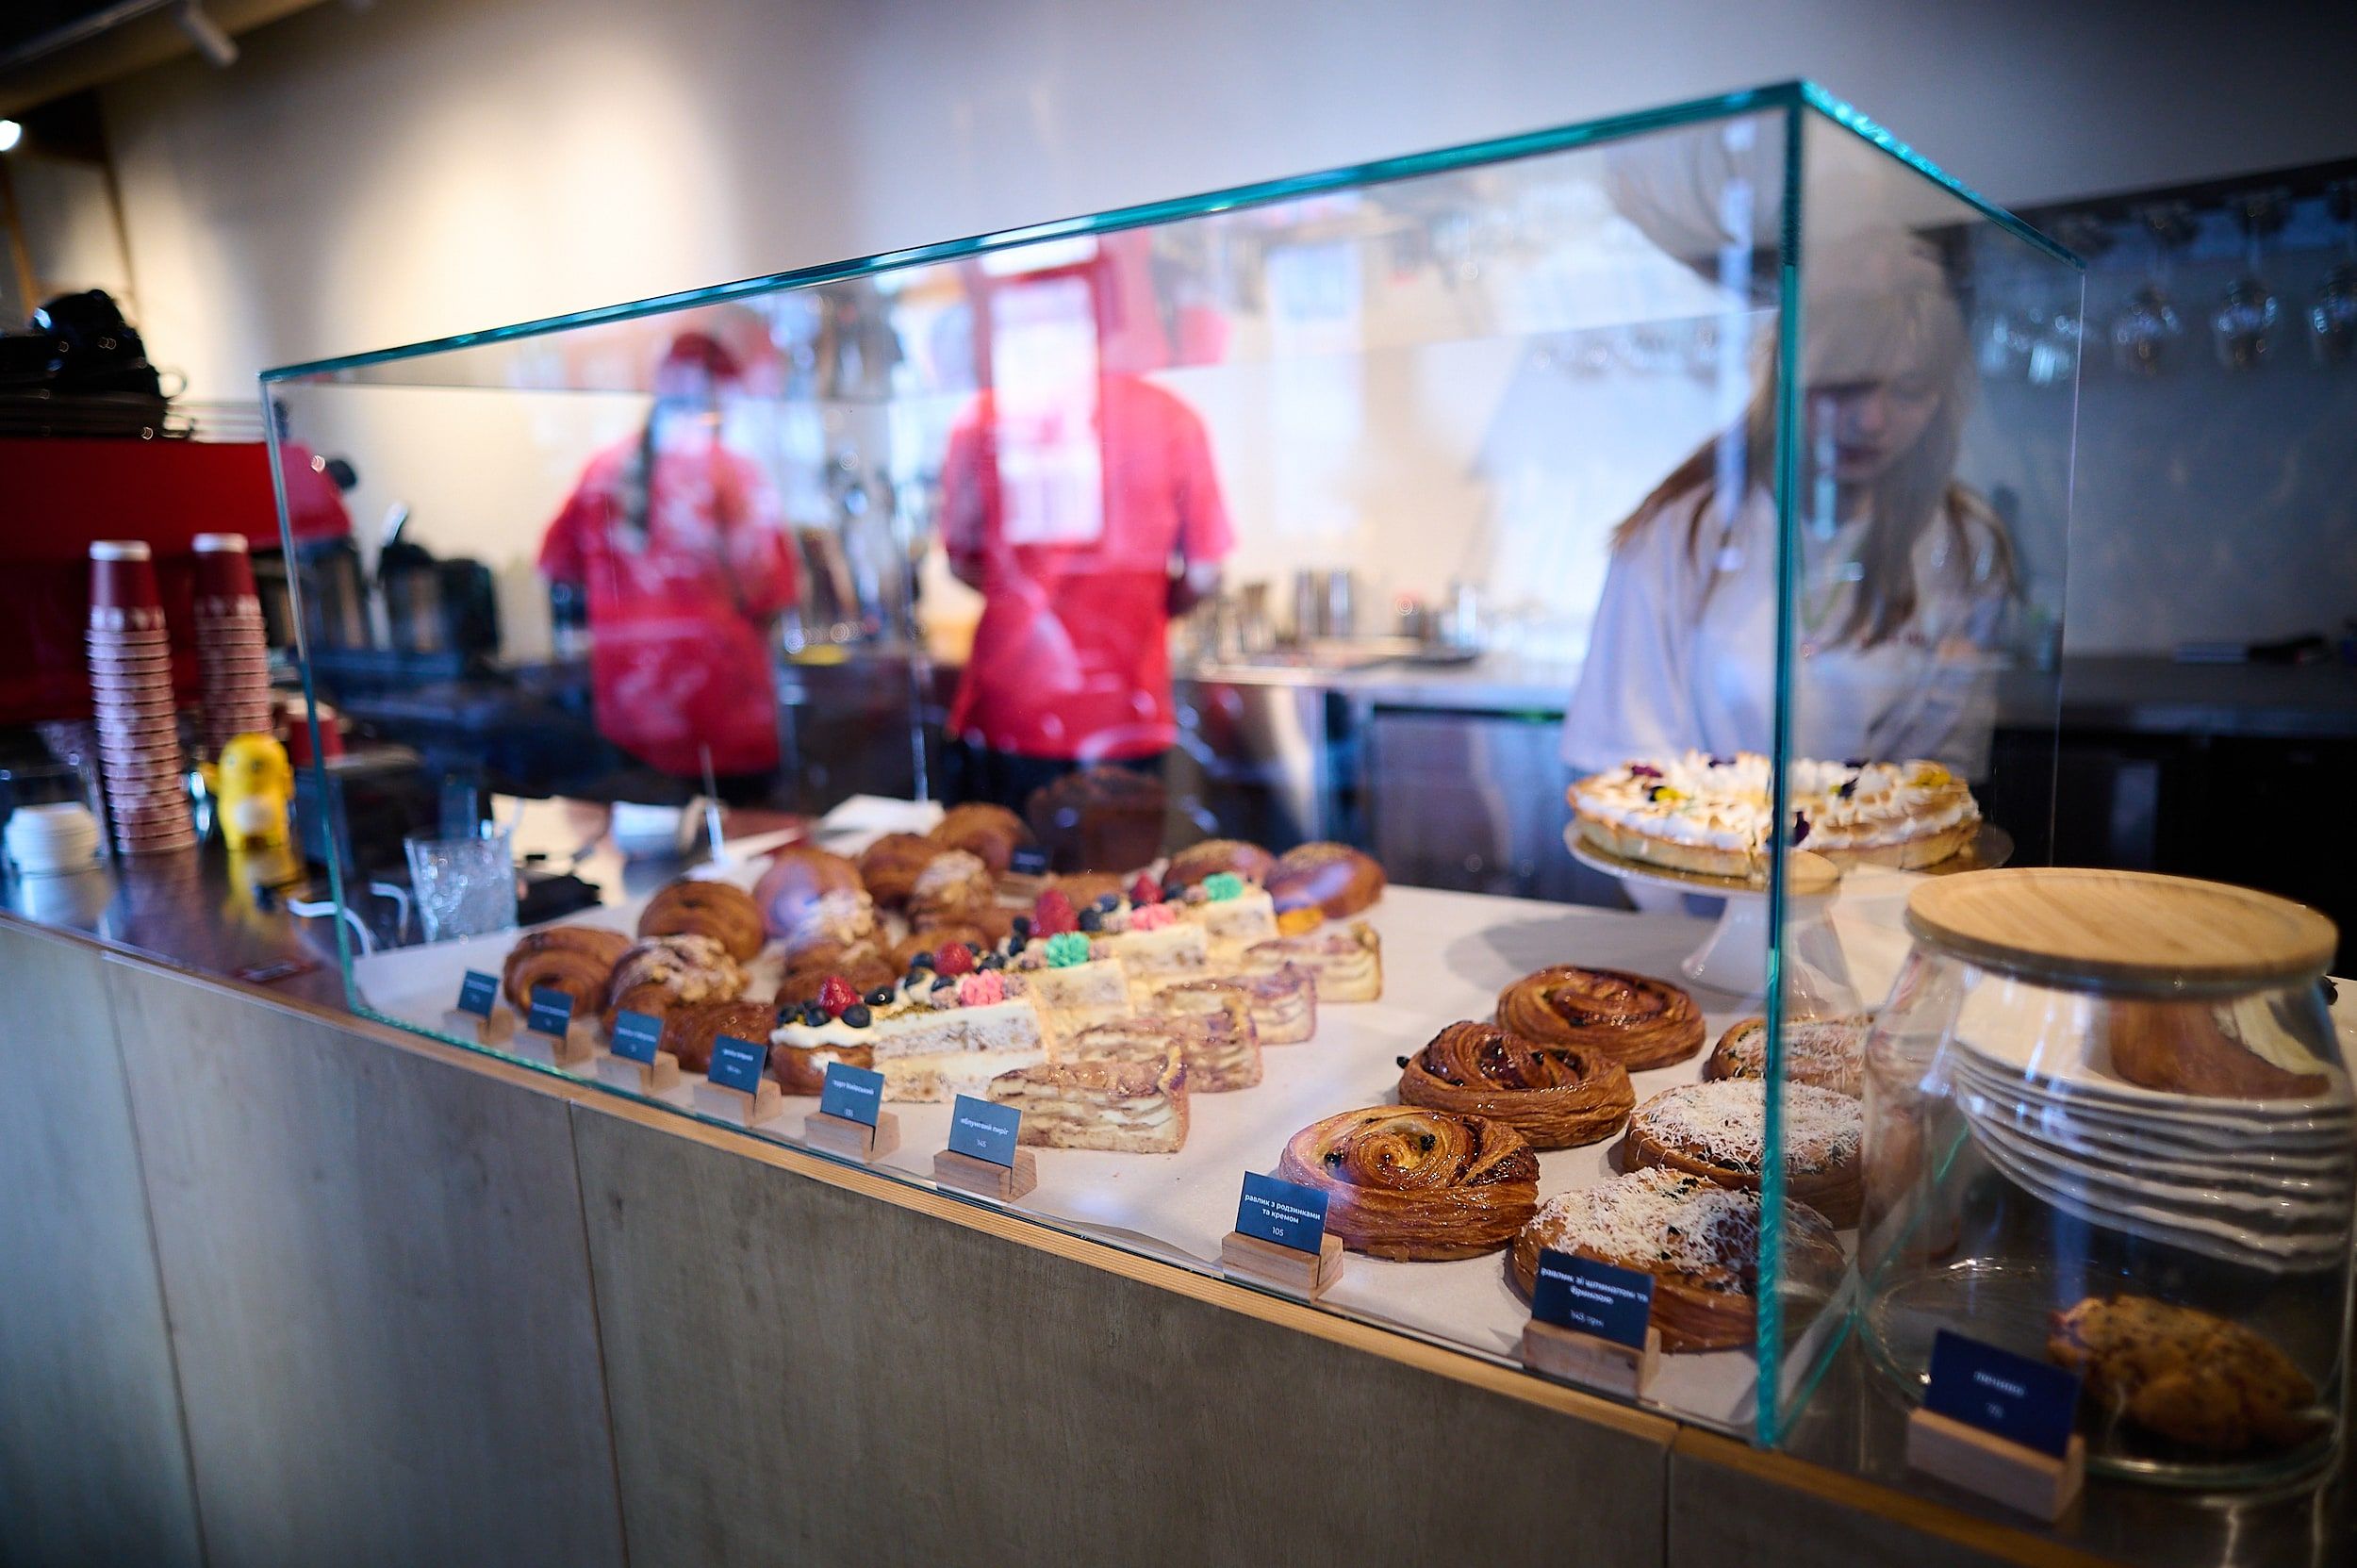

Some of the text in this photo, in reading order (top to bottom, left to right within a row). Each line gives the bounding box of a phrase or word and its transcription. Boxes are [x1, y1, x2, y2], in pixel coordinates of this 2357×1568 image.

[1244, 1194, 1270, 1206] равлик
[1276, 1203, 1321, 1221] родзинками
[1271, 1211, 1299, 1224] кремом
[1272, 1226, 1284, 1237] 105
[1541, 1267, 1575, 1283] равлик
[1585, 1279, 1636, 1300] шпинатом
